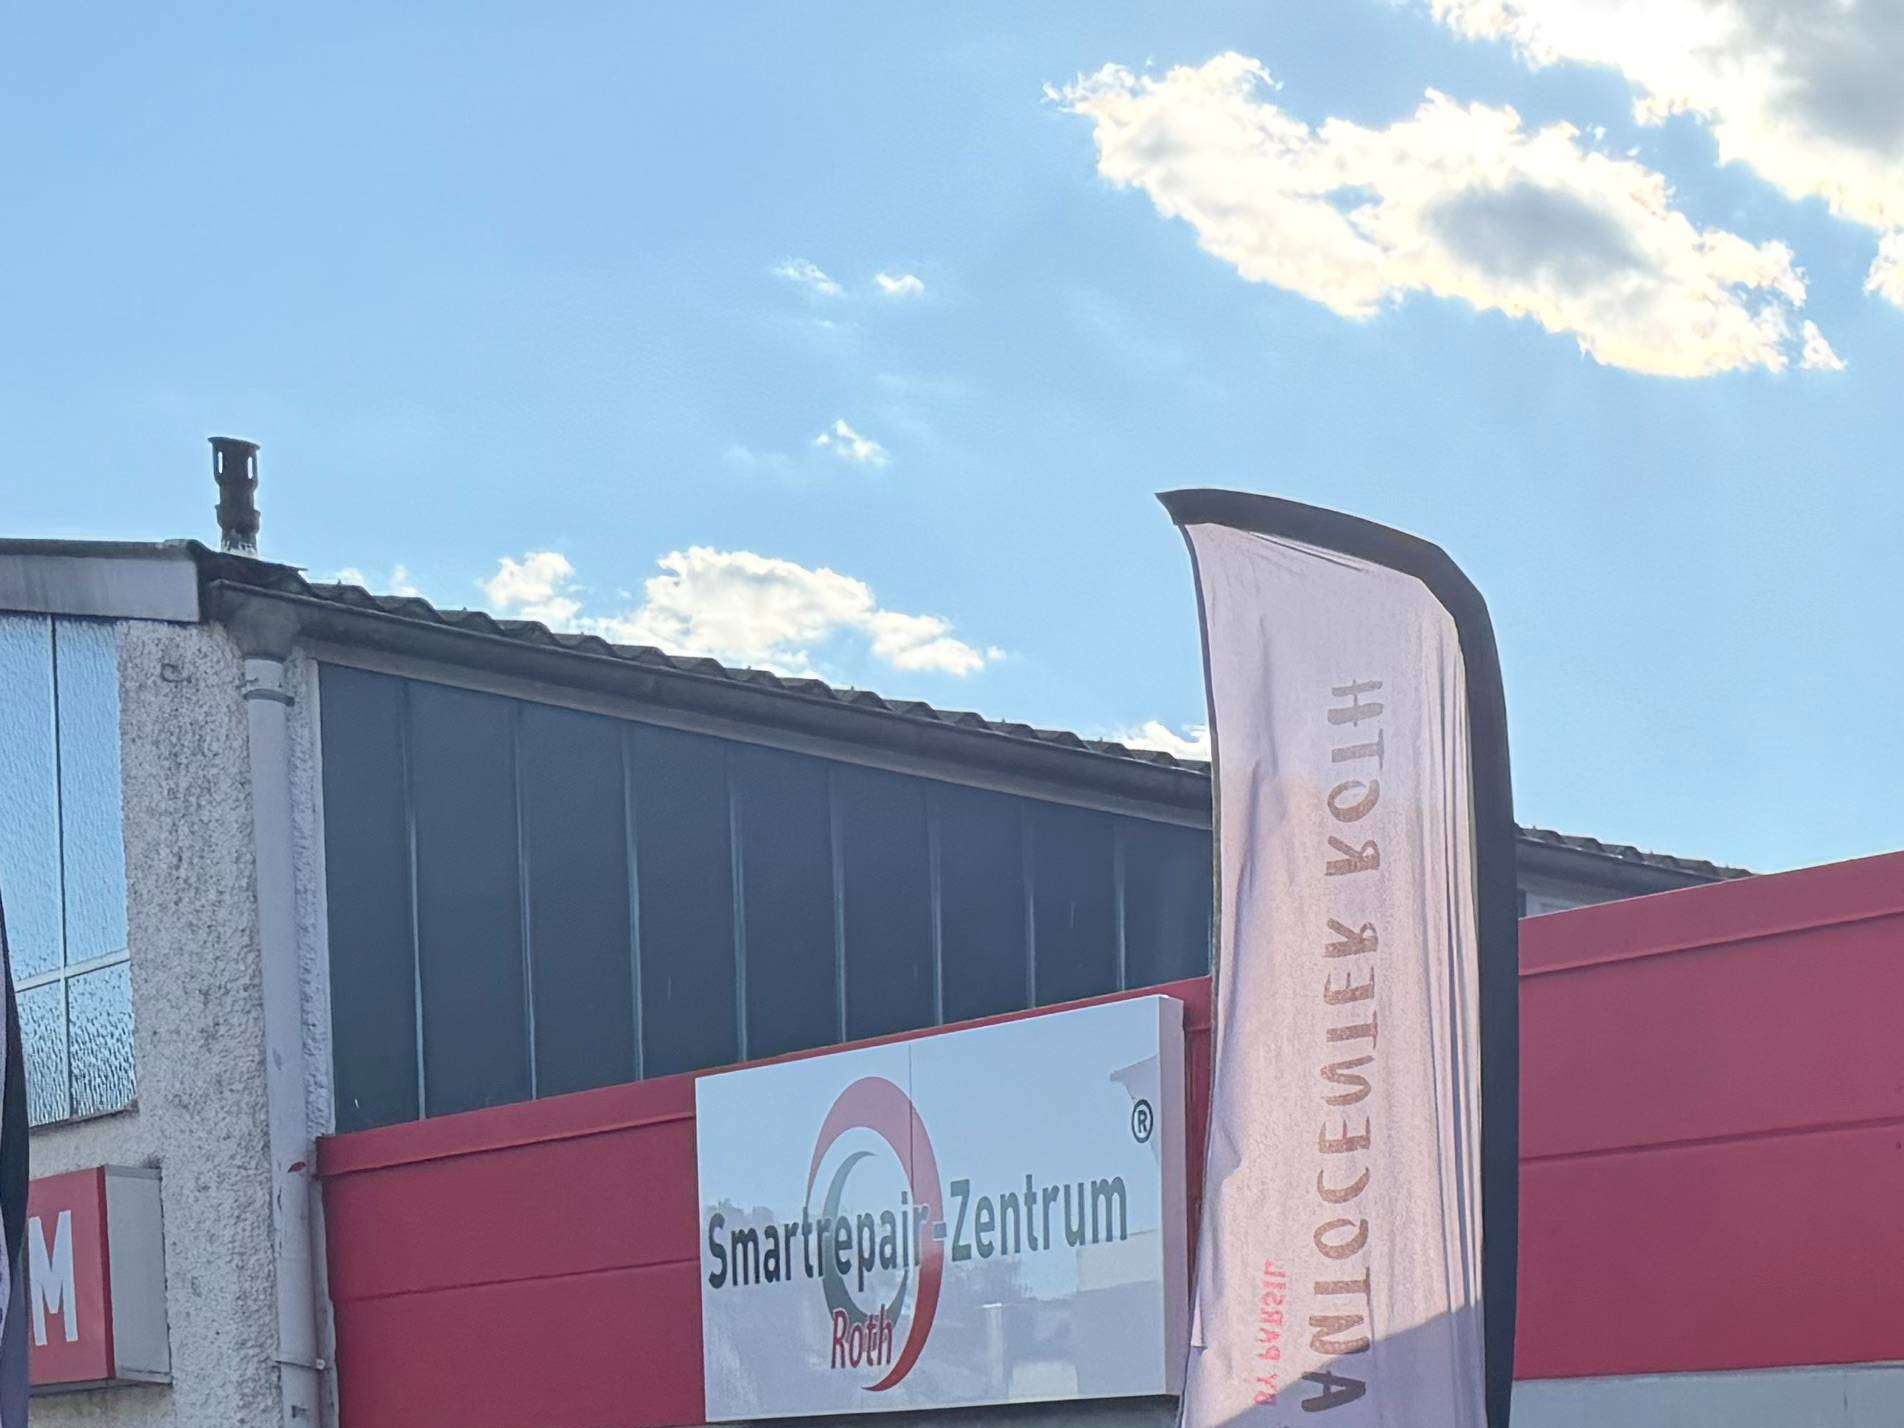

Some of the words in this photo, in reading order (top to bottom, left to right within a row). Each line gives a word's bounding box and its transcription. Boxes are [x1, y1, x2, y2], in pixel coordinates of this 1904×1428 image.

[28, 1210, 79, 1347] M
[708, 1174, 1128, 1293] Smartrepair-Zentrum
[831, 1303, 894, 1369] Roth
